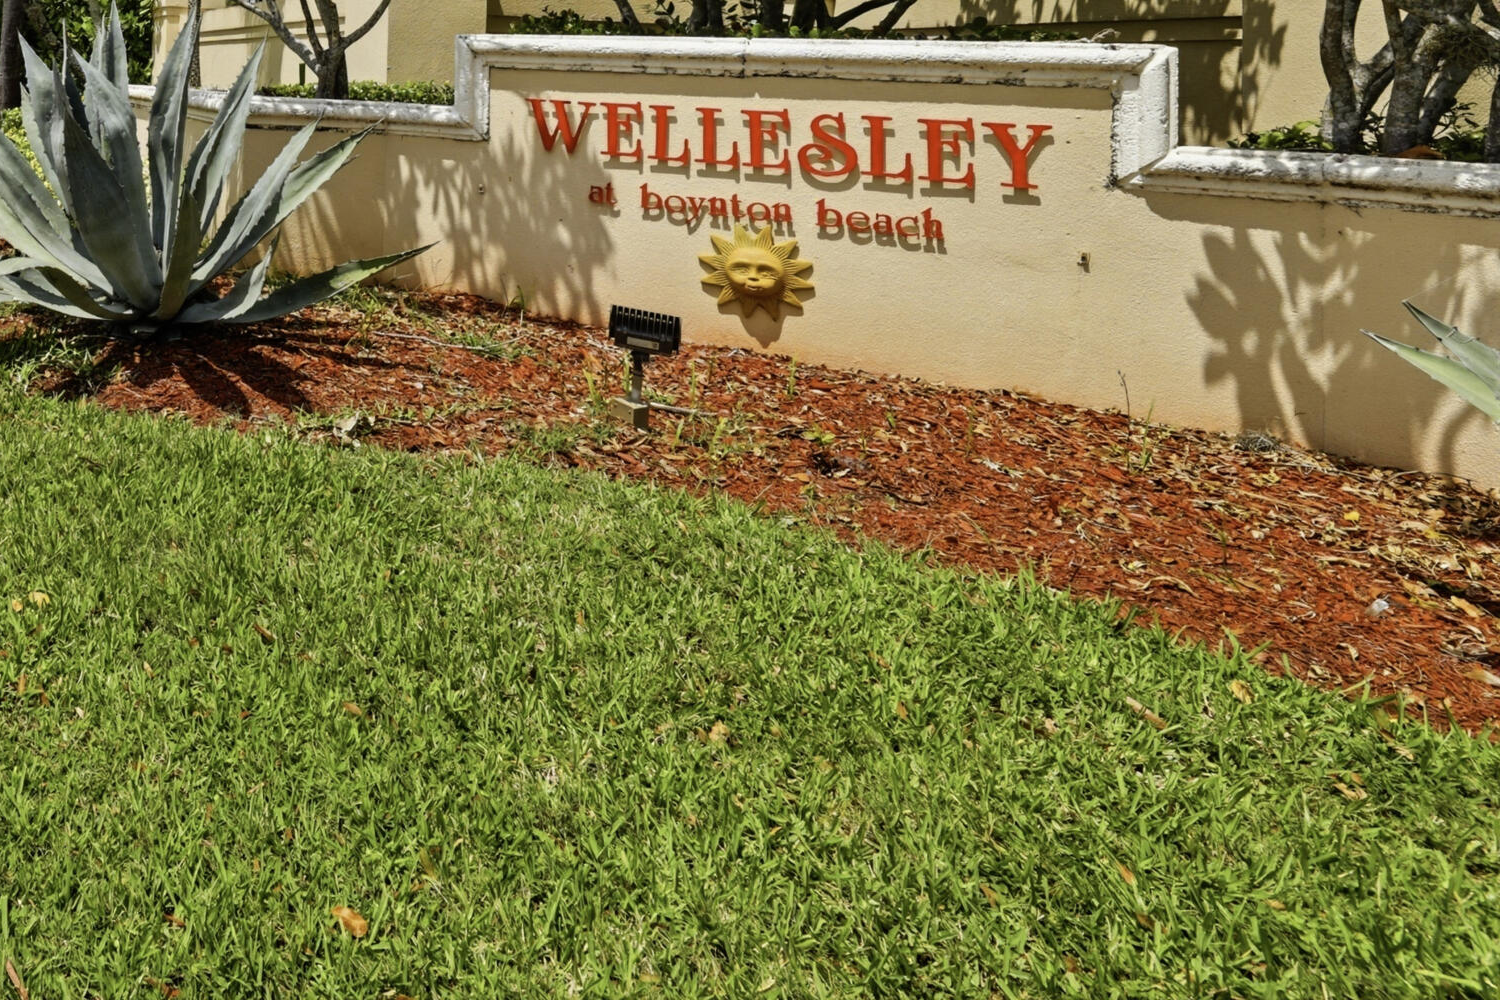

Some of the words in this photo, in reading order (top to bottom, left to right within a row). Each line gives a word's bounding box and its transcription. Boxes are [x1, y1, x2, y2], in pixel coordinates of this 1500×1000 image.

[525, 97, 1053, 190] WELLESLEY
[587, 181, 618, 206] at
[639, 182, 793, 225] boynton
[815, 198, 945, 241] beach
